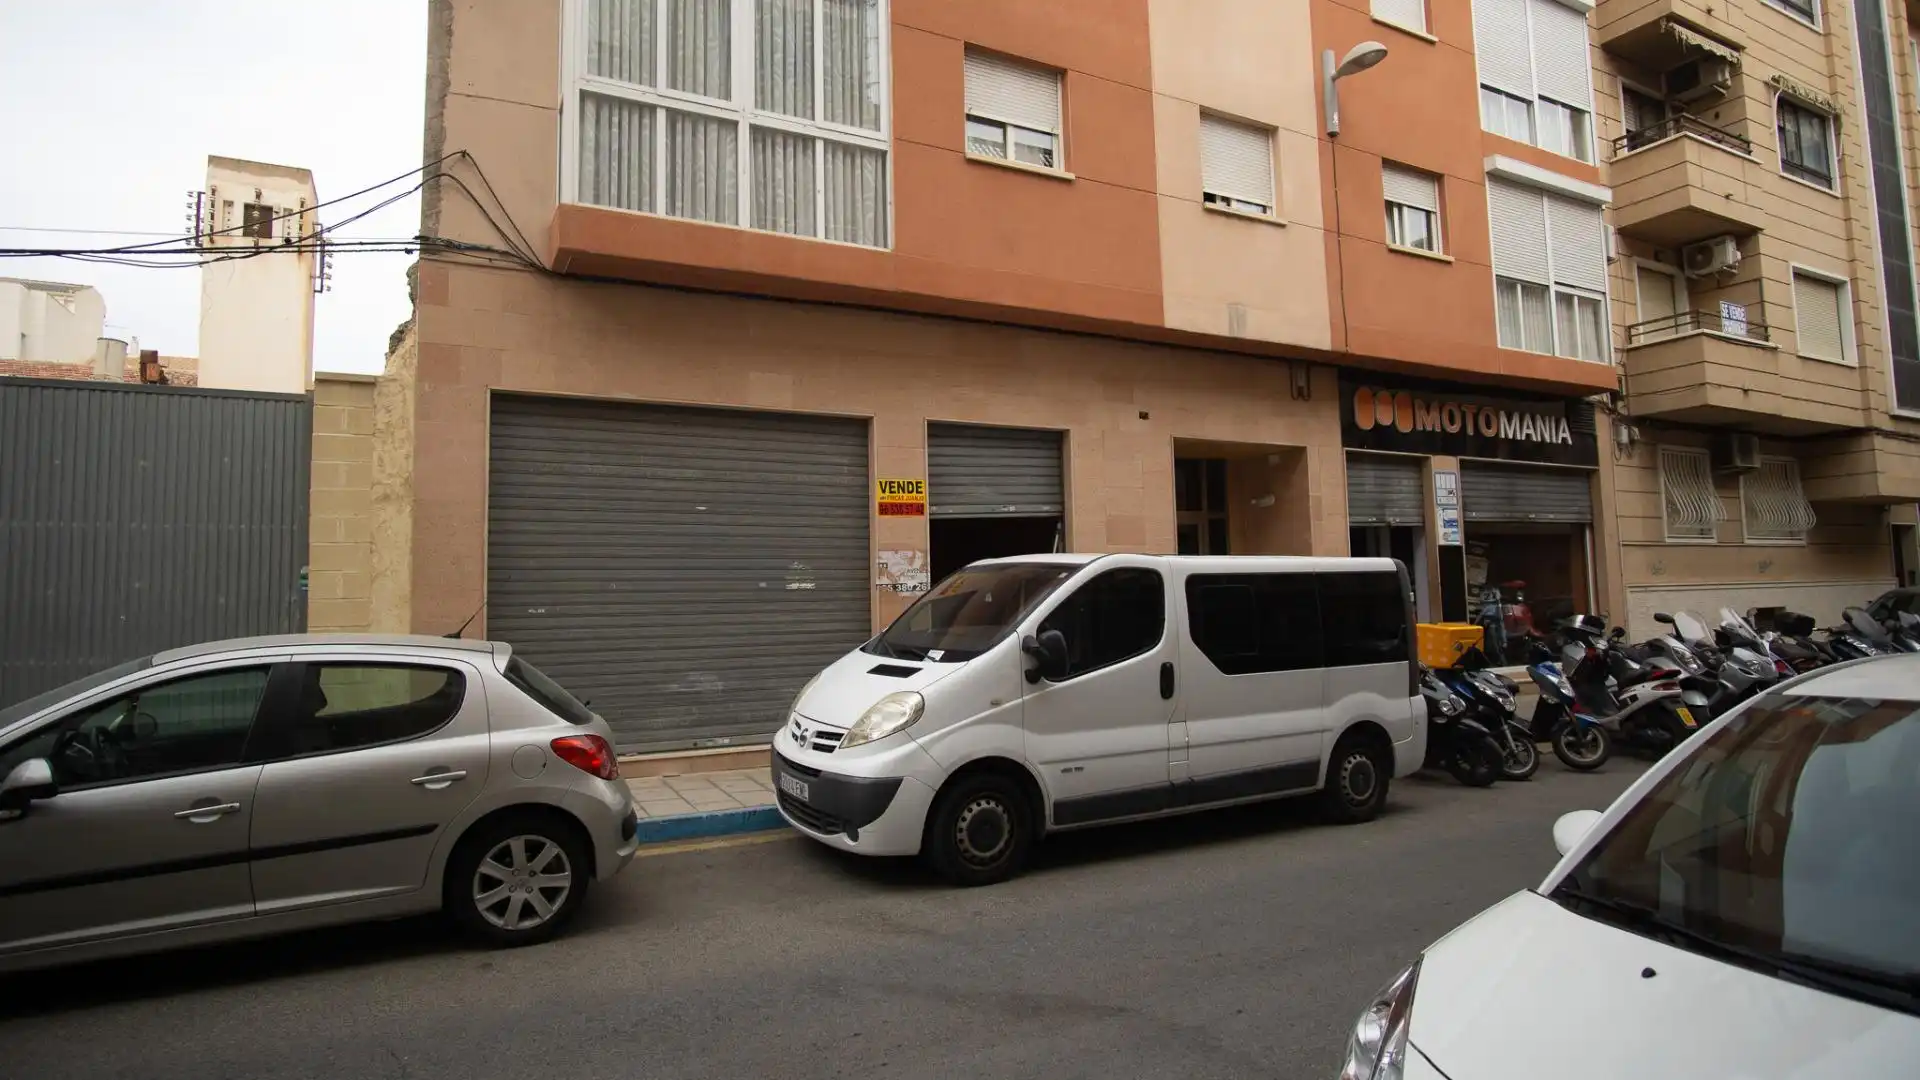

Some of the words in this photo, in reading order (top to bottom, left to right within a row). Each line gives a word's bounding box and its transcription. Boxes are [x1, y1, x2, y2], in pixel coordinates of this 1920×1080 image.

[1721, 303, 1729, 318] SE
[1729, 304, 1746, 321] VENDE
[1414, 399, 1573, 445] MOTOMANIA
[879, 480, 923, 494] VENDE
